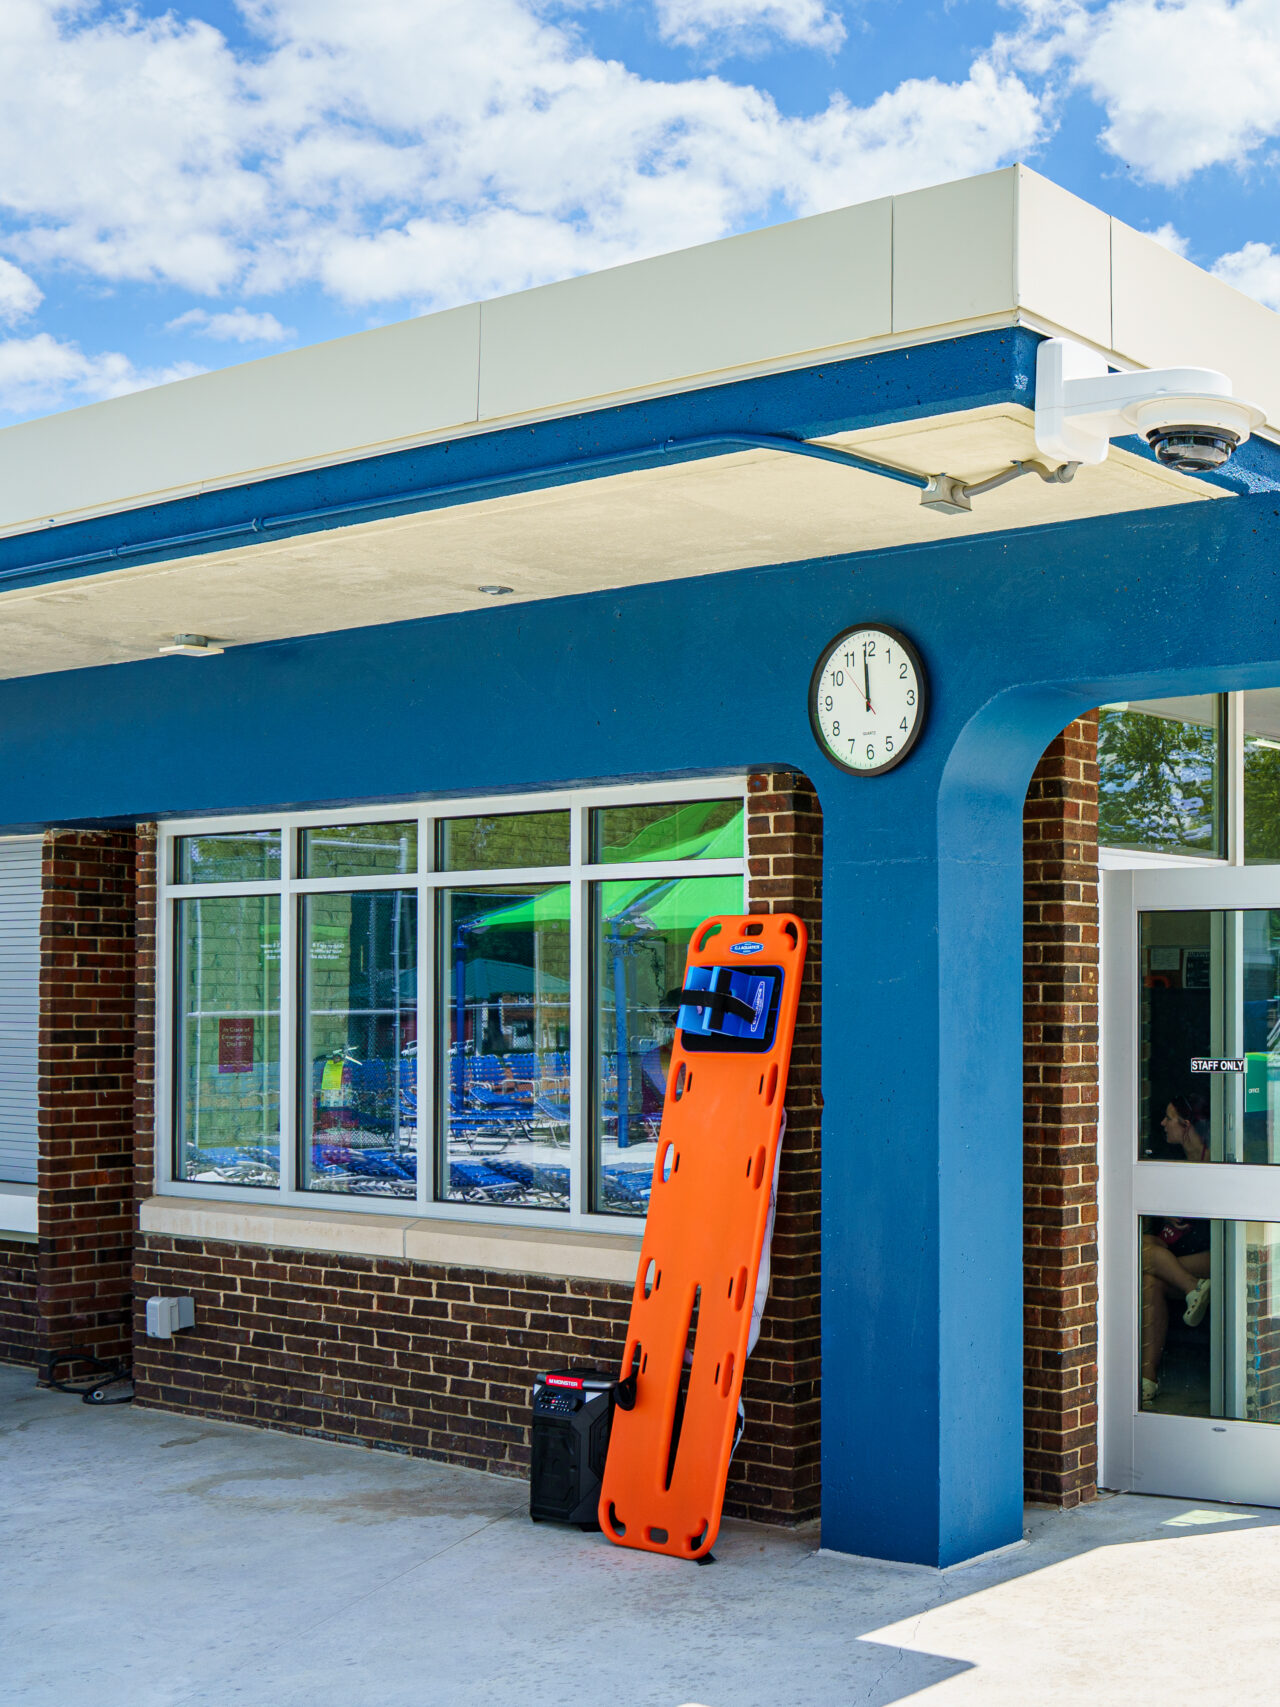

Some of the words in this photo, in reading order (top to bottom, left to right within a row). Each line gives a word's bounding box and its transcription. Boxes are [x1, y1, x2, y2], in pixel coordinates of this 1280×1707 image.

[862, 641, 876, 657] 12
[886, 648, 891, 664] 1
[844, 651, 855, 667] 11
[830, 671, 844, 686] 10
[899, 663, 908, 679] 2
[825, 696, 833, 711] 9
[906, 690, 915, 705] 3
[832, 721, 840, 736] 8
[899, 716, 908, 732] 4
[848, 739, 855, 754] 7
[885, 736, 893, 751] 5
[866, 744, 874, 760] 6
[1192, 1060, 1219, 1070] STAFF
[1220, 1060, 1244, 1071] ONLY
[554, 1379, 578, 1387] MONSTER
